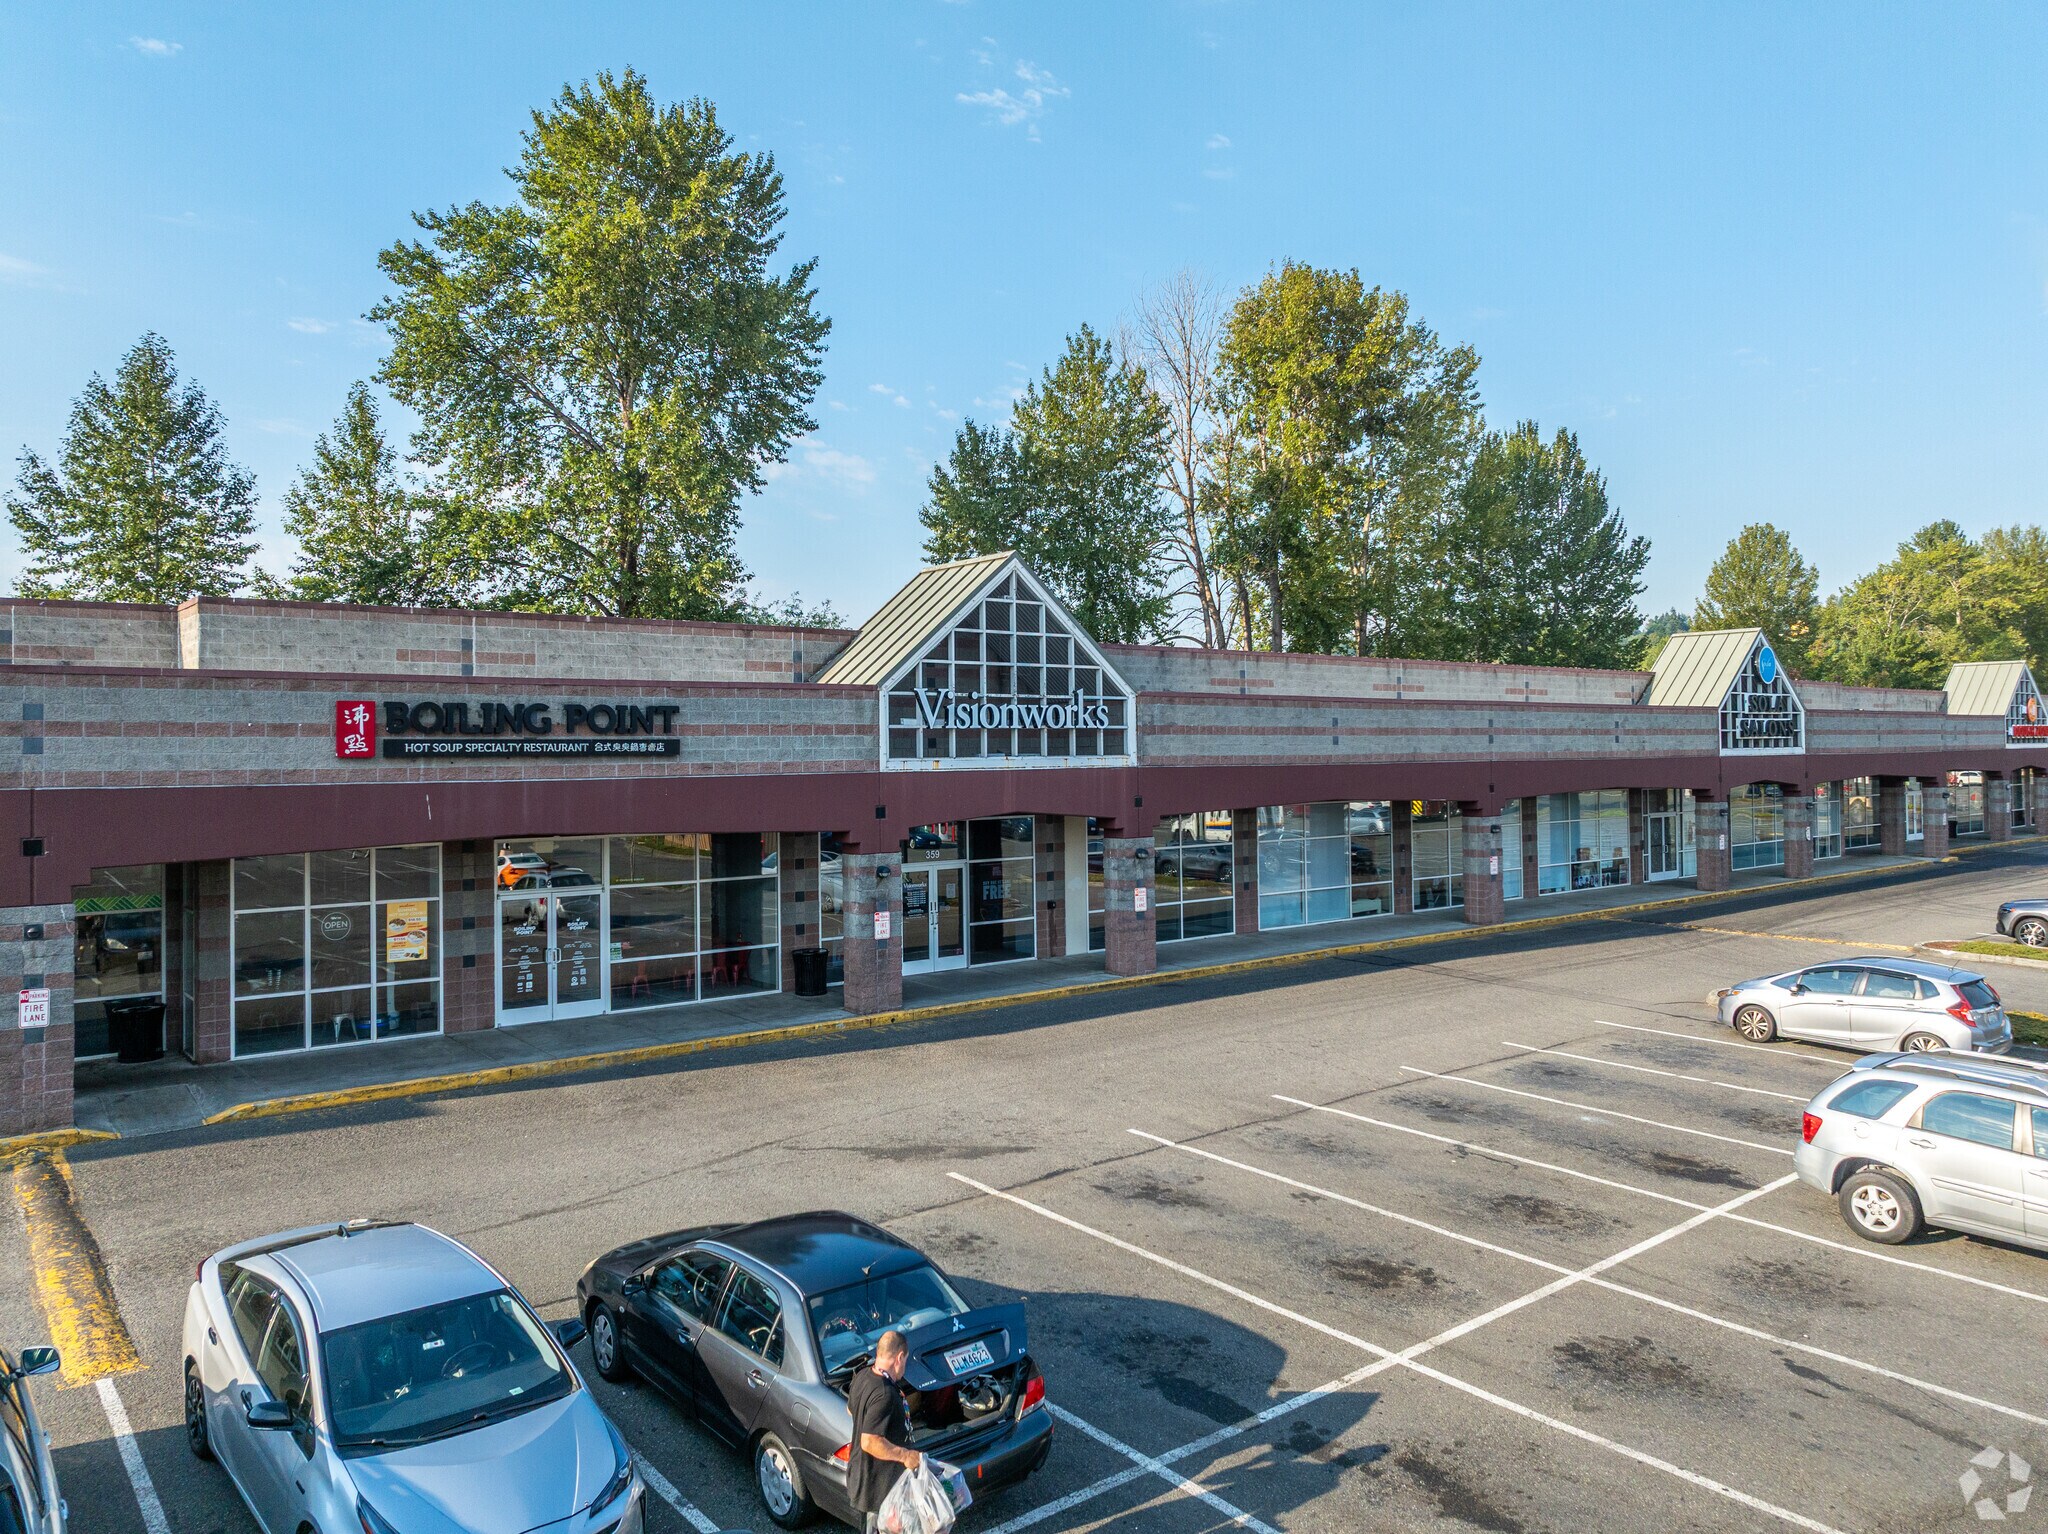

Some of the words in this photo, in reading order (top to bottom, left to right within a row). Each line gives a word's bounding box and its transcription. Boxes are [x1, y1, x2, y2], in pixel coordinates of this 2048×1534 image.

[914, 687, 1109, 729] Visionworks
[1750, 695, 1787, 713] SOLA
[383, 701, 551, 735] BOILING
[563, 703, 680, 735] POINT
[1742, 719, 1795, 737] SALONS
[404, 743, 431, 753] HOT
[432, 743, 463, 753] SOUP
[465, 743, 522, 753] SPECIALTY
[523, 743, 590, 753] RESTAURANT
[925, 849, 940, 860] 359
[982, 884, 1012, 900] FREE
[324, 920, 348, 930] OPEN
[20, 992, 29, 1001] NO
[24, 1004, 44, 1012] FIRE
[24, 1014, 46, 1022] LANE
[950, 1349, 990, 1370] CLM4623
